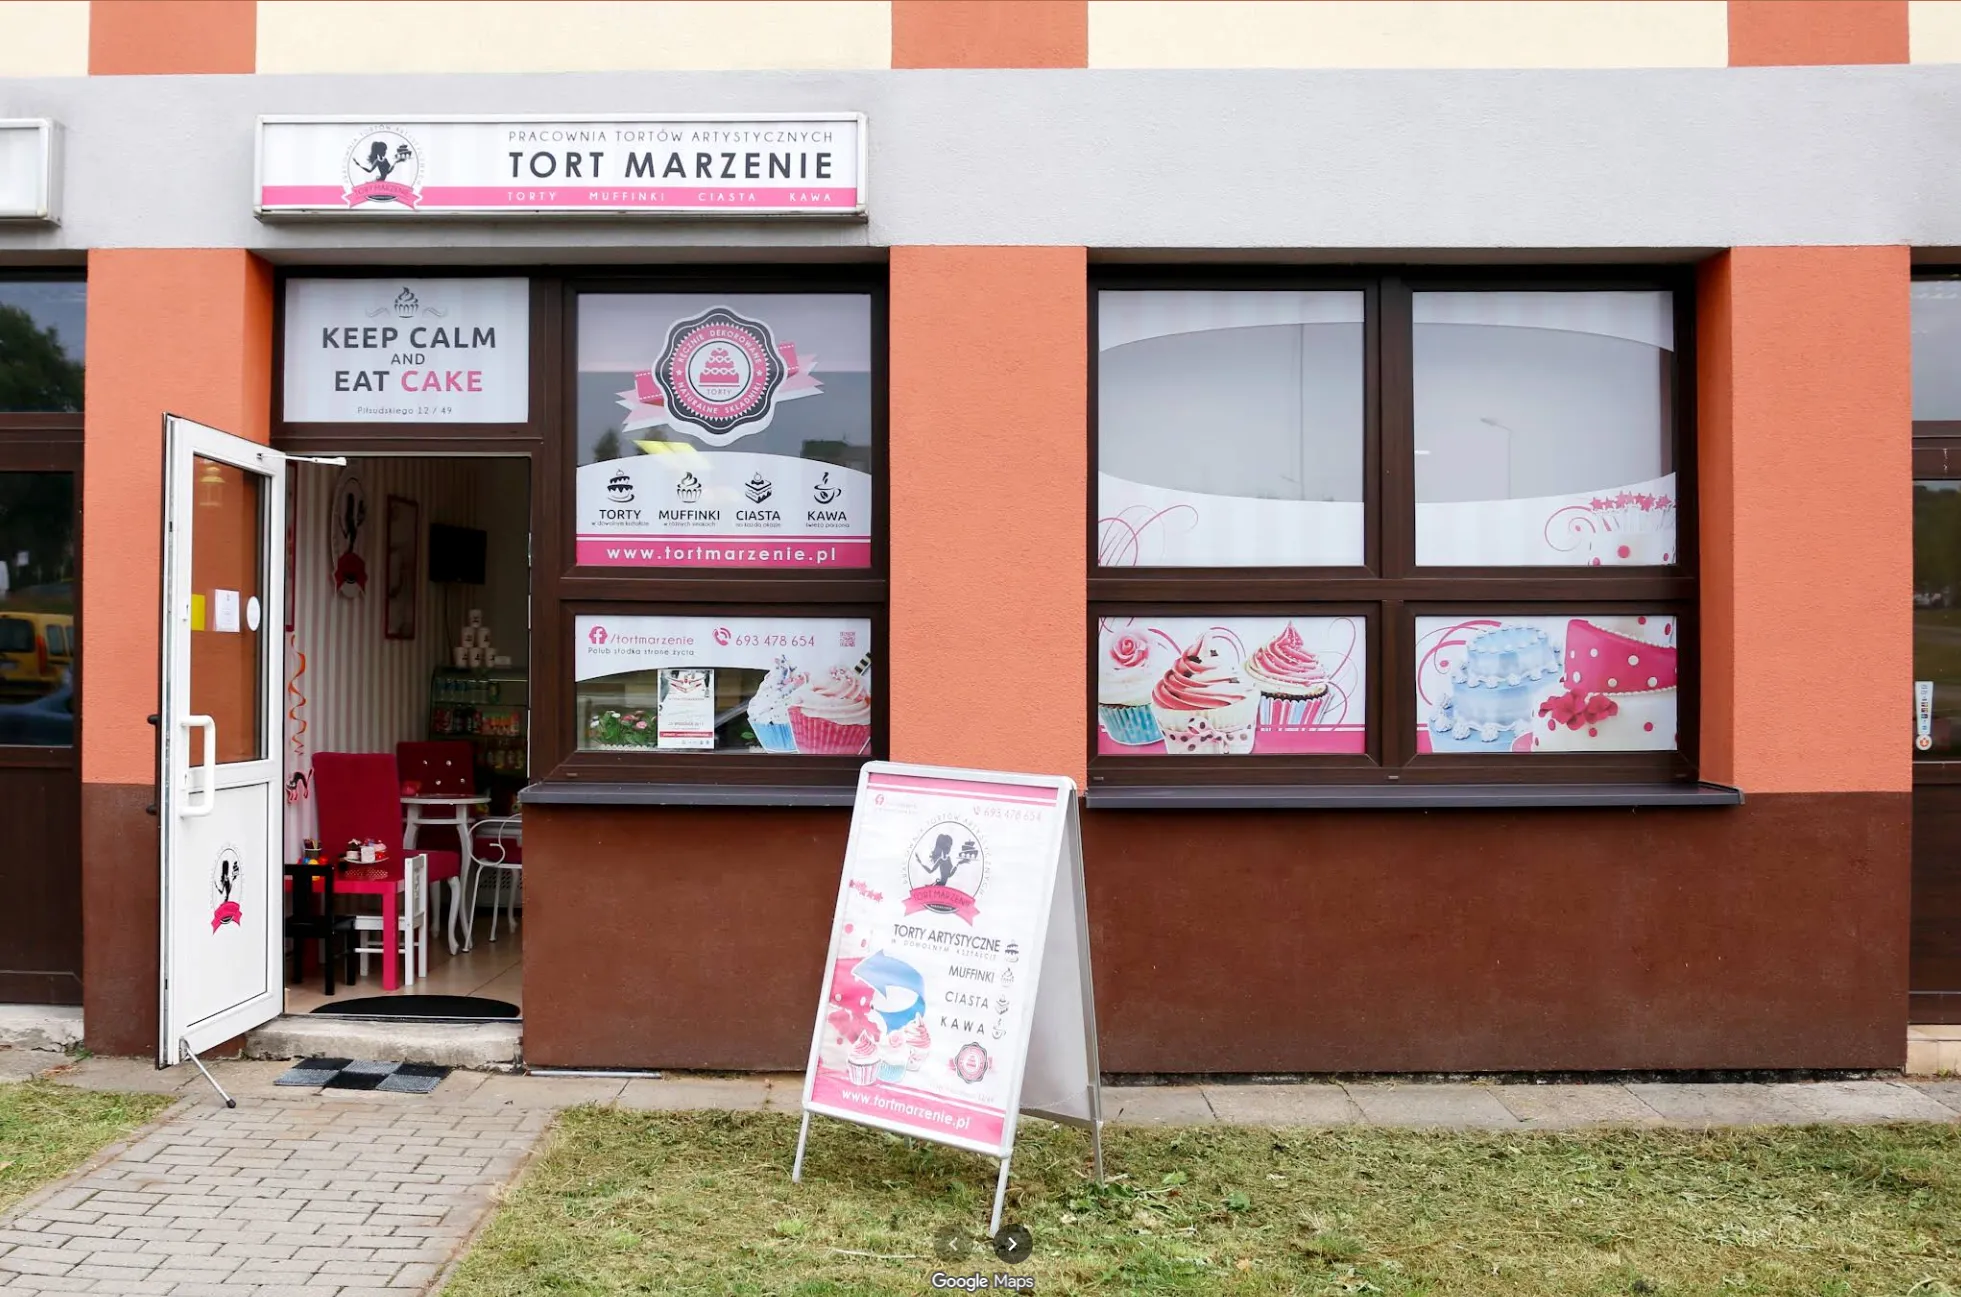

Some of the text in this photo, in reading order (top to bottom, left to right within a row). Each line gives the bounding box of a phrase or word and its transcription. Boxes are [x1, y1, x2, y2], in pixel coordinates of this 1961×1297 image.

[508, 129, 833, 143] PRACOWNIA TORTÓW ARTYSTYCZNYCH
[509, 151, 831, 179] TORT MARZENIE
[507, 191, 831, 202] TORTY MUFFINKI CIASTA KAWA
[322, 326, 496, 349] KEEP CALM
[709, 330, 762, 363] DEKOROWANE
[390, 353, 425, 365] AND
[334, 370, 483, 392] EAT CAKE
[677, 382, 718, 414] NATURALNE
[706, 388, 732, 396] TORTY
[418, 406, 429, 415] 12
[440, 406, 452, 414] 49
[599, 509, 642, 520] TORTY
[658, 510, 720, 520] MUFFINKI
[736, 510, 781, 521] CIASTA
[807, 510, 847, 521] KAWA
[606, 545, 837, 564] www.tortmarzenie.pl
[610, 633, 694, 646] /tortmarzenie
[735, 635, 815, 647] 693 478 654
[587, 646, 611, 655] Polub
[984, 808, 1042, 822] 693 478 654
[893, 924, 1001, 952] TORTY ARTYSTYCZNE
[948, 965, 995, 984] MUFFINKI
[944, 991, 989, 1009] CIASTA
[940, 1016, 986, 1035] KAWA
[841, 1088, 971, 1130] www.tortmarzenie.pl
